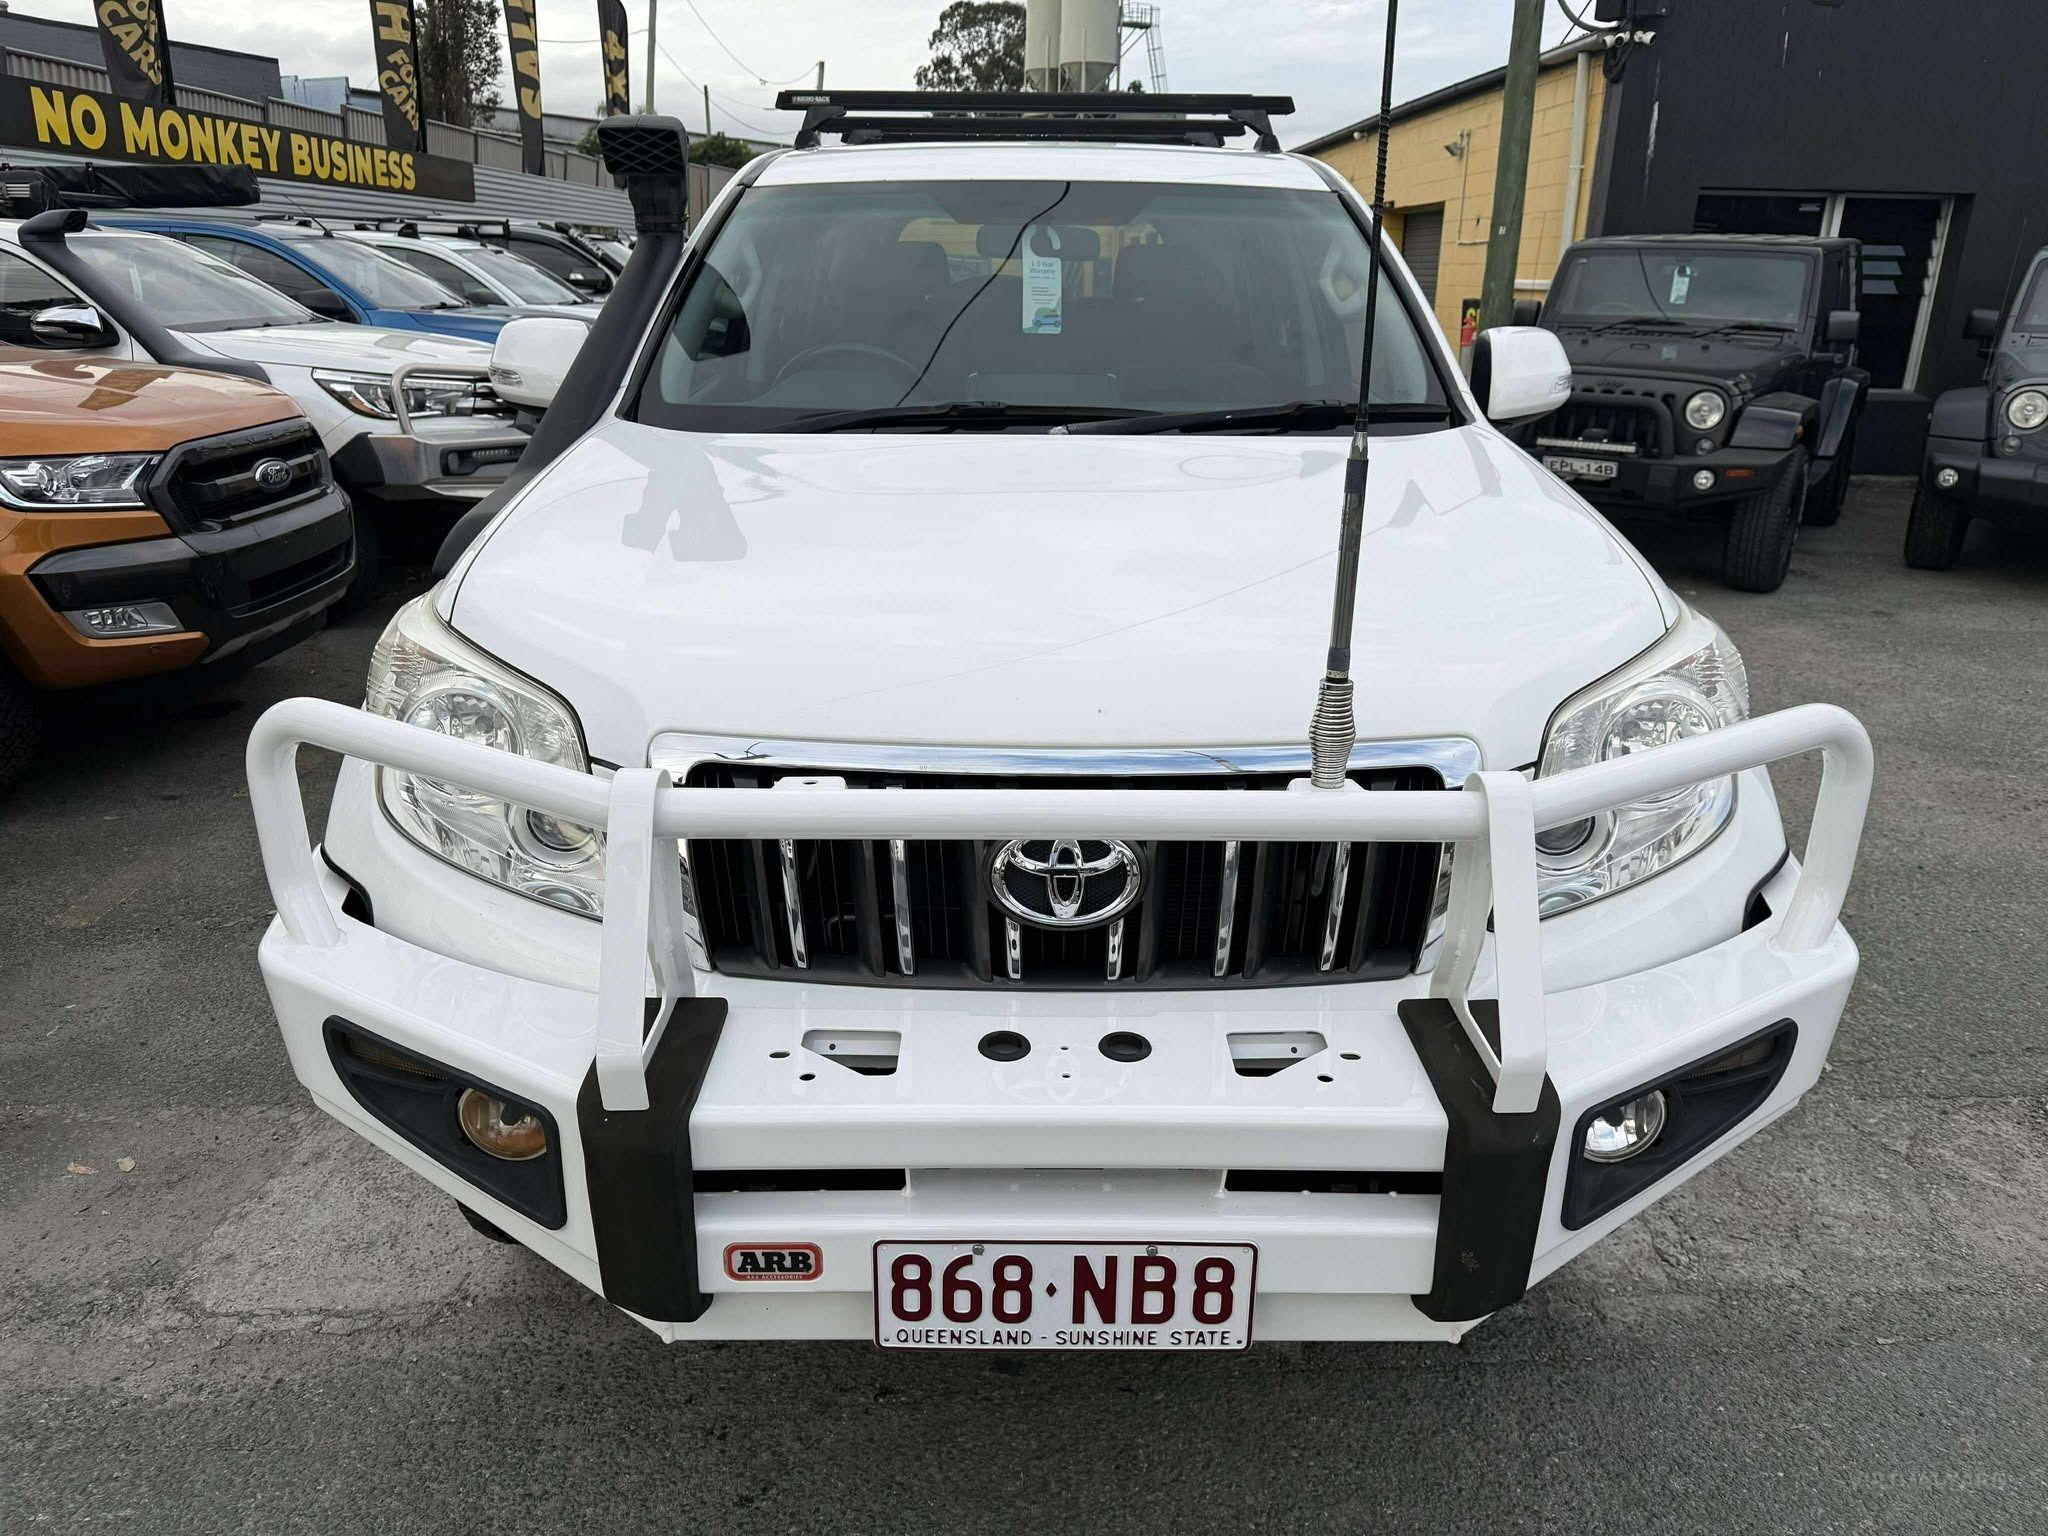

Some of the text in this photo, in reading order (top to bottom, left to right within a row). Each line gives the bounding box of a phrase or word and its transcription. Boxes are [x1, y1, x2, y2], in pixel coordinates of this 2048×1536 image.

[30, 86, 416, 191] NO MONKEY BUSINESS
[267, 465, 288, 483] Ford
[738, 1251, 812, 1272] ARB
[896, 1329, 1032, 1345] QUEENSLAND
[1055, 1330, 1158, 1346] SUNSHINE
[1170, 1330, 1231, 1346] STATE
